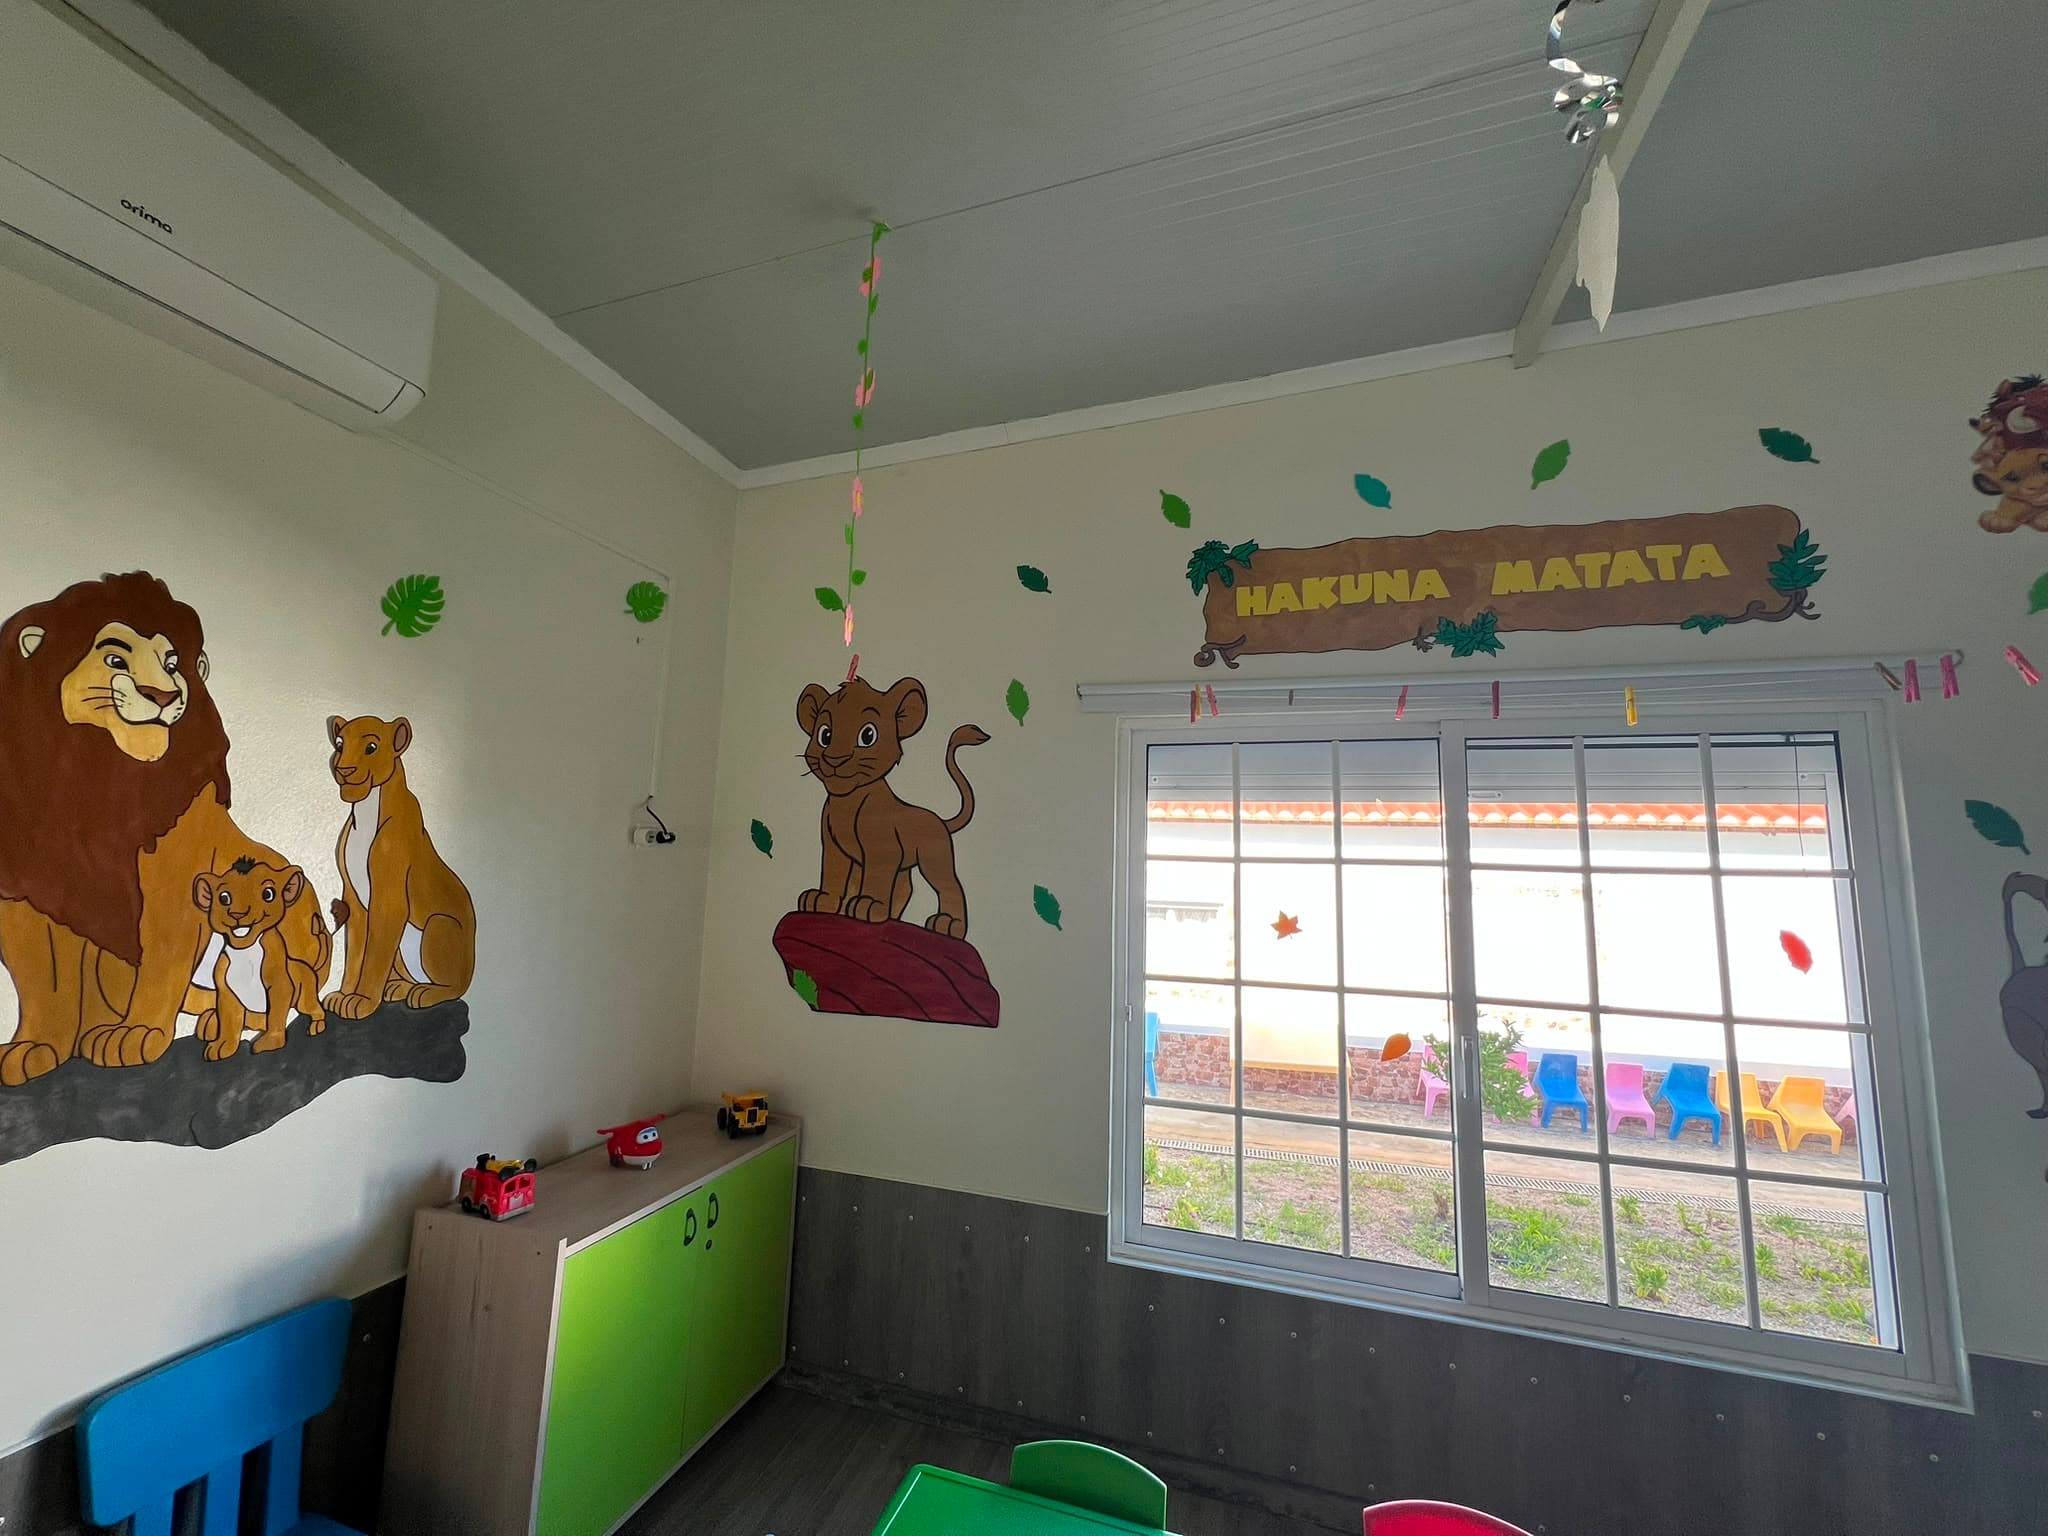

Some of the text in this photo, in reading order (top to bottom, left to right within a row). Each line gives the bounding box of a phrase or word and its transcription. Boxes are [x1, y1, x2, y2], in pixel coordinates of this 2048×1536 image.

[120, 199, 172, 234] orima
[1235, 543, 1730, 617] HAKUNA MATATA
